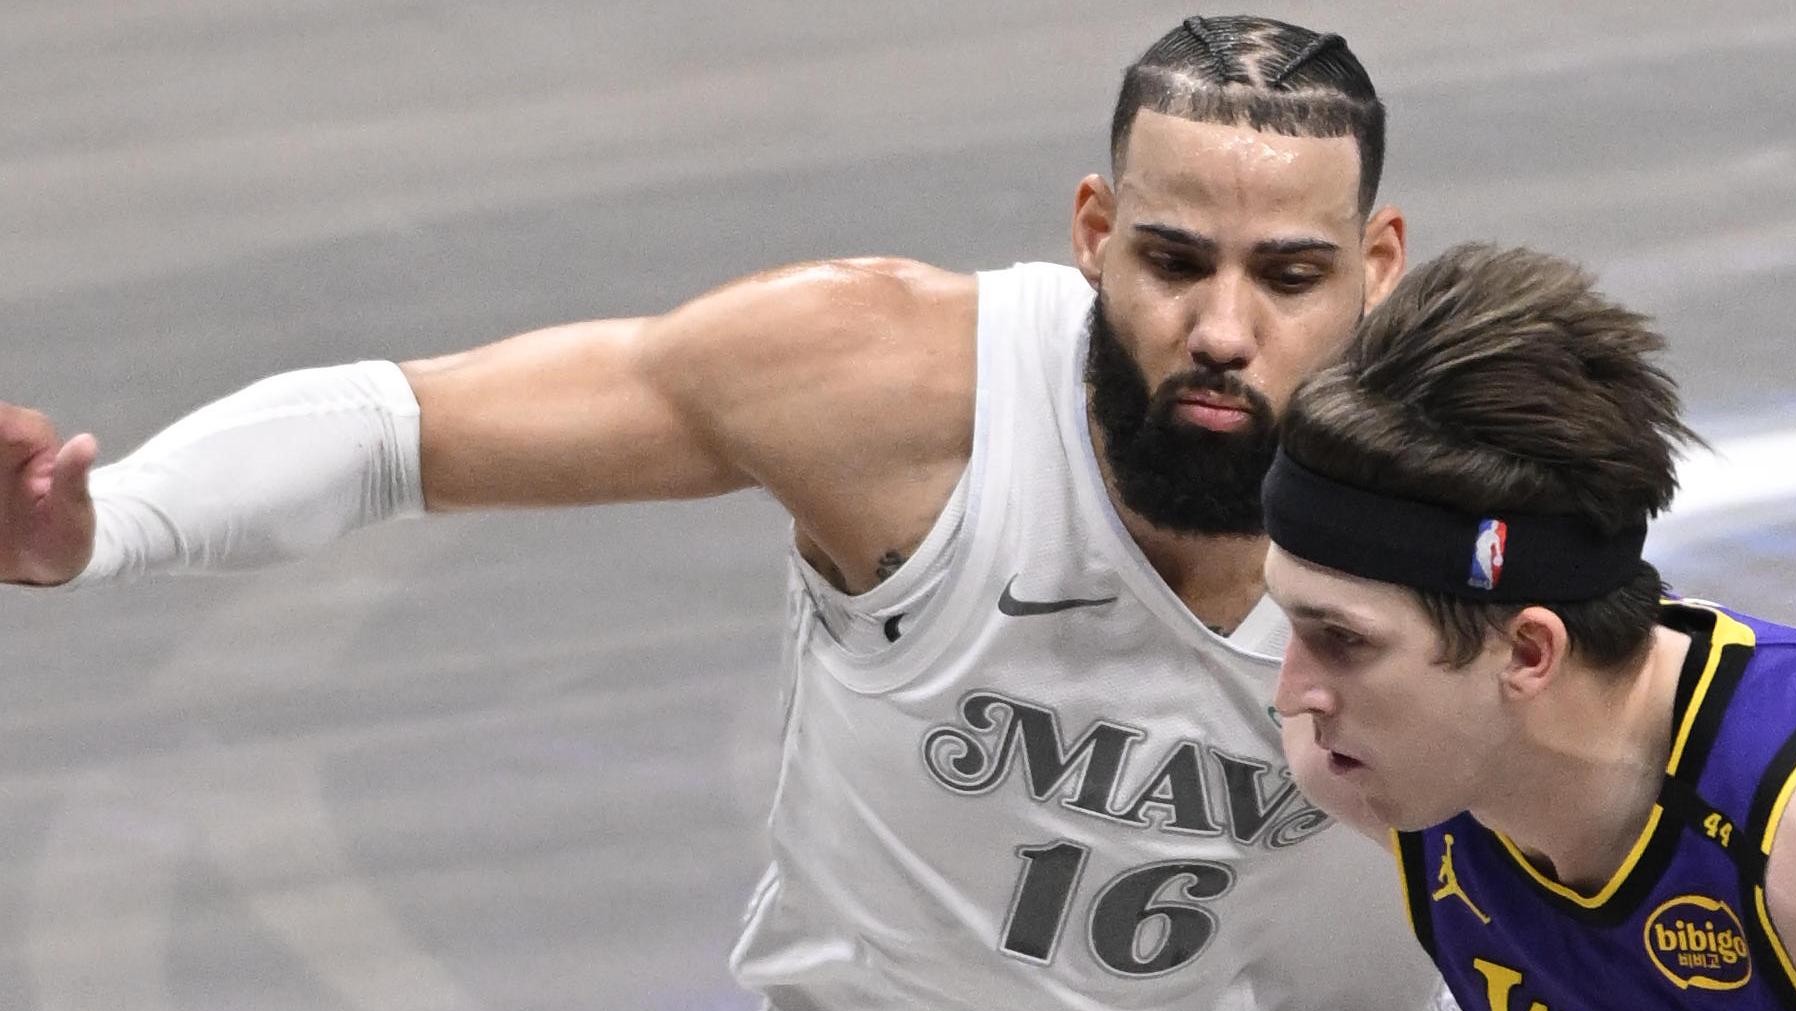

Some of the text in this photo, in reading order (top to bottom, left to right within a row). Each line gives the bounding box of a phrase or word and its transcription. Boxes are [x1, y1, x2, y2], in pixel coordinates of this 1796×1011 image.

[1703, 812, 1733, 848] 44
[997, 837, 1238, 979] 16
[1655, 920, 1748, 964] bibigo
